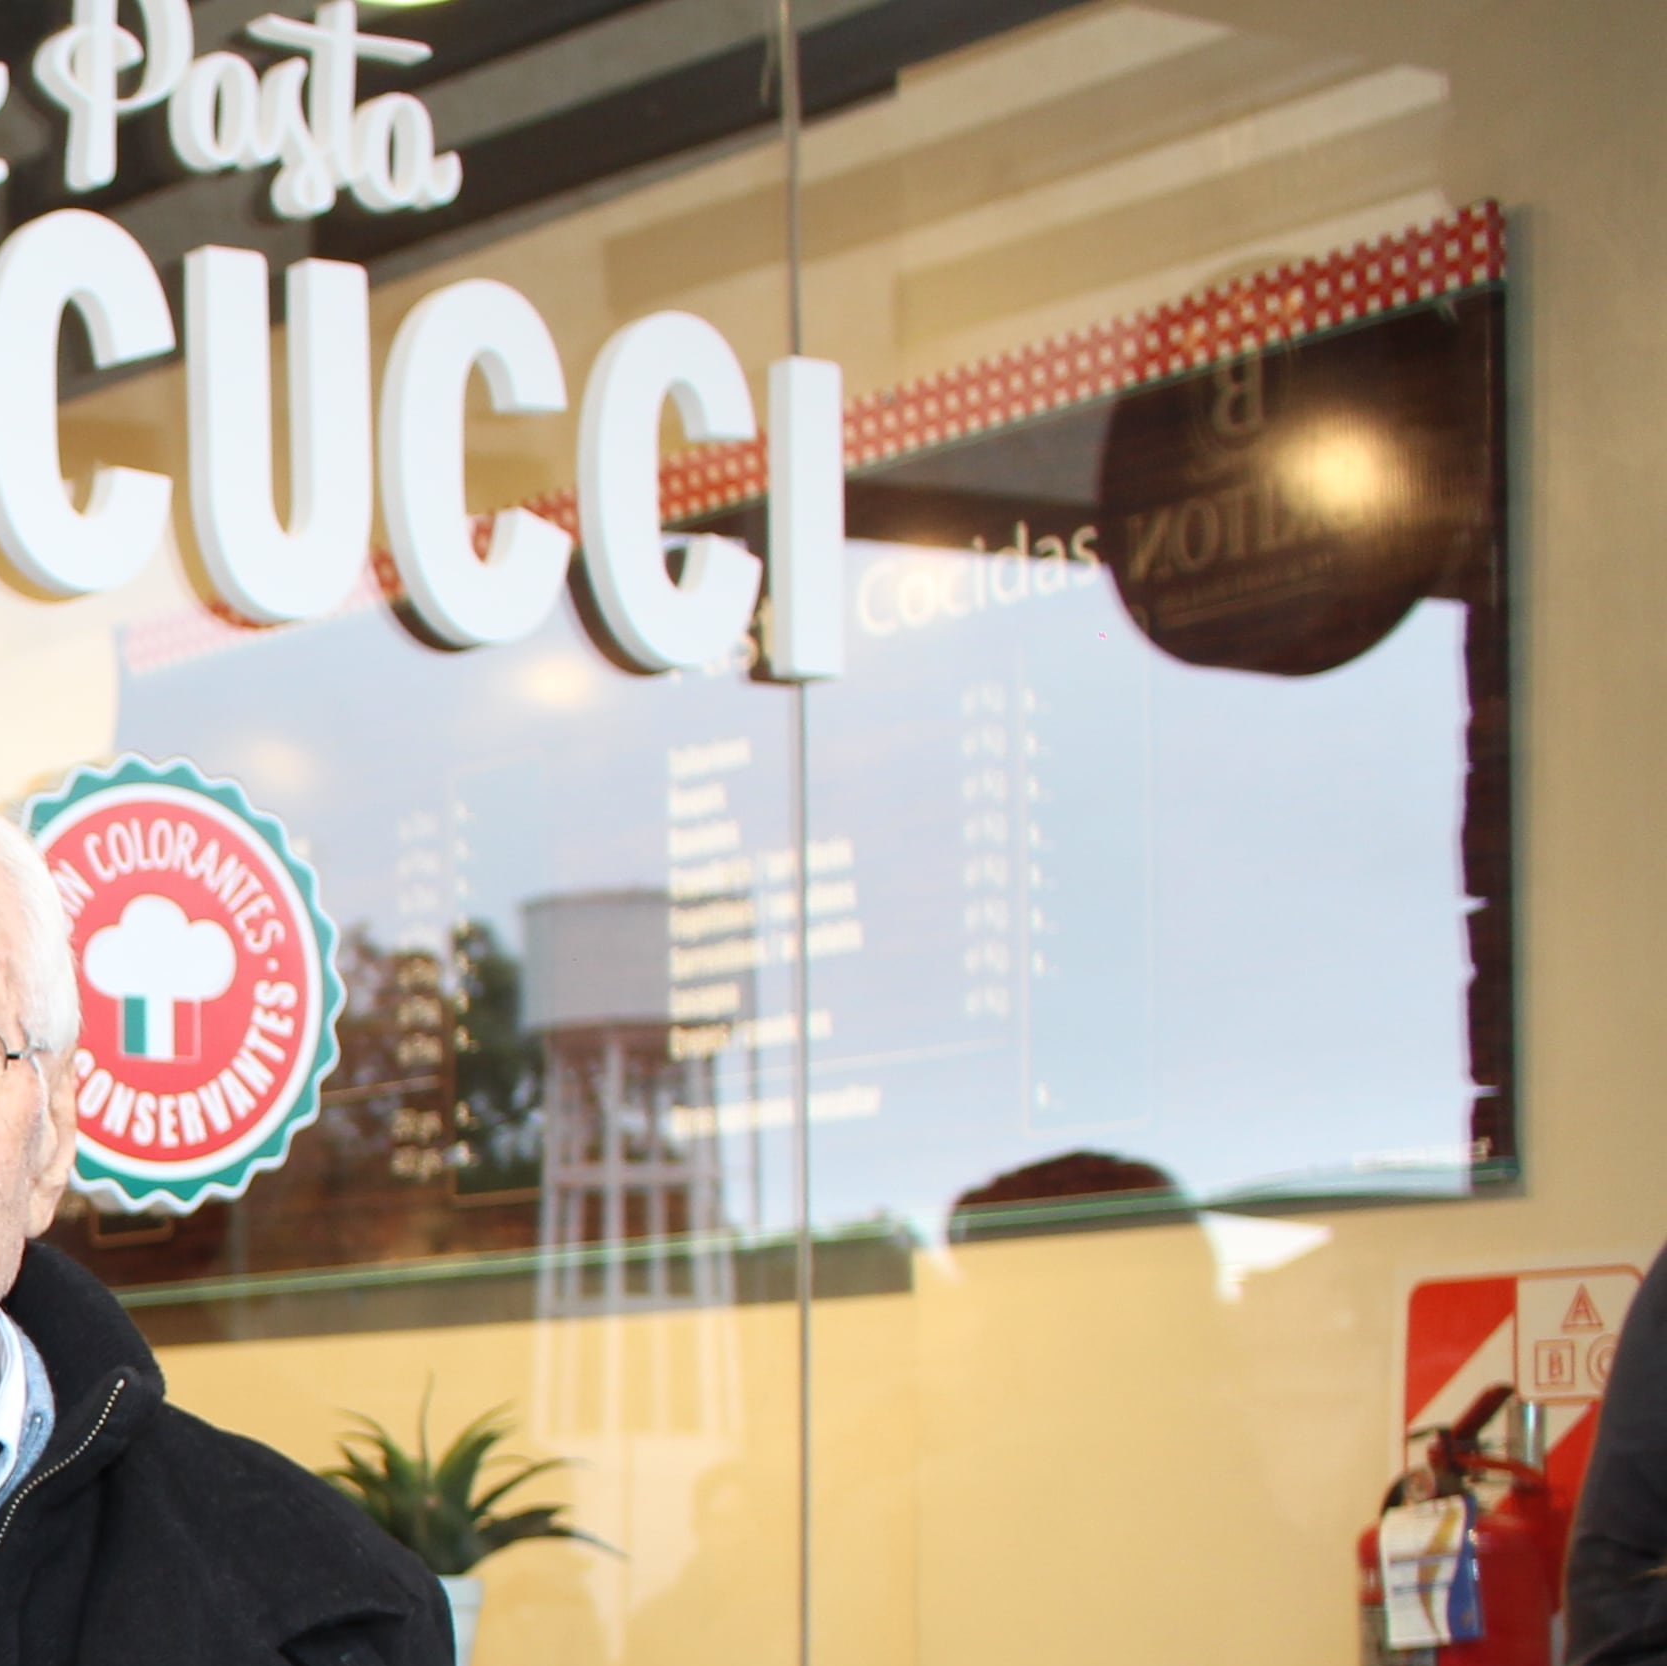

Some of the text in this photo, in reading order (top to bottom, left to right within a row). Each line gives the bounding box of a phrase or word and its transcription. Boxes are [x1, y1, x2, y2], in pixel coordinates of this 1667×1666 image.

[32, 0, 463, 219] Pasta
[855, 520, 1099, 637] Cocidas
[84, 817, 286, 955] COLORANTES
